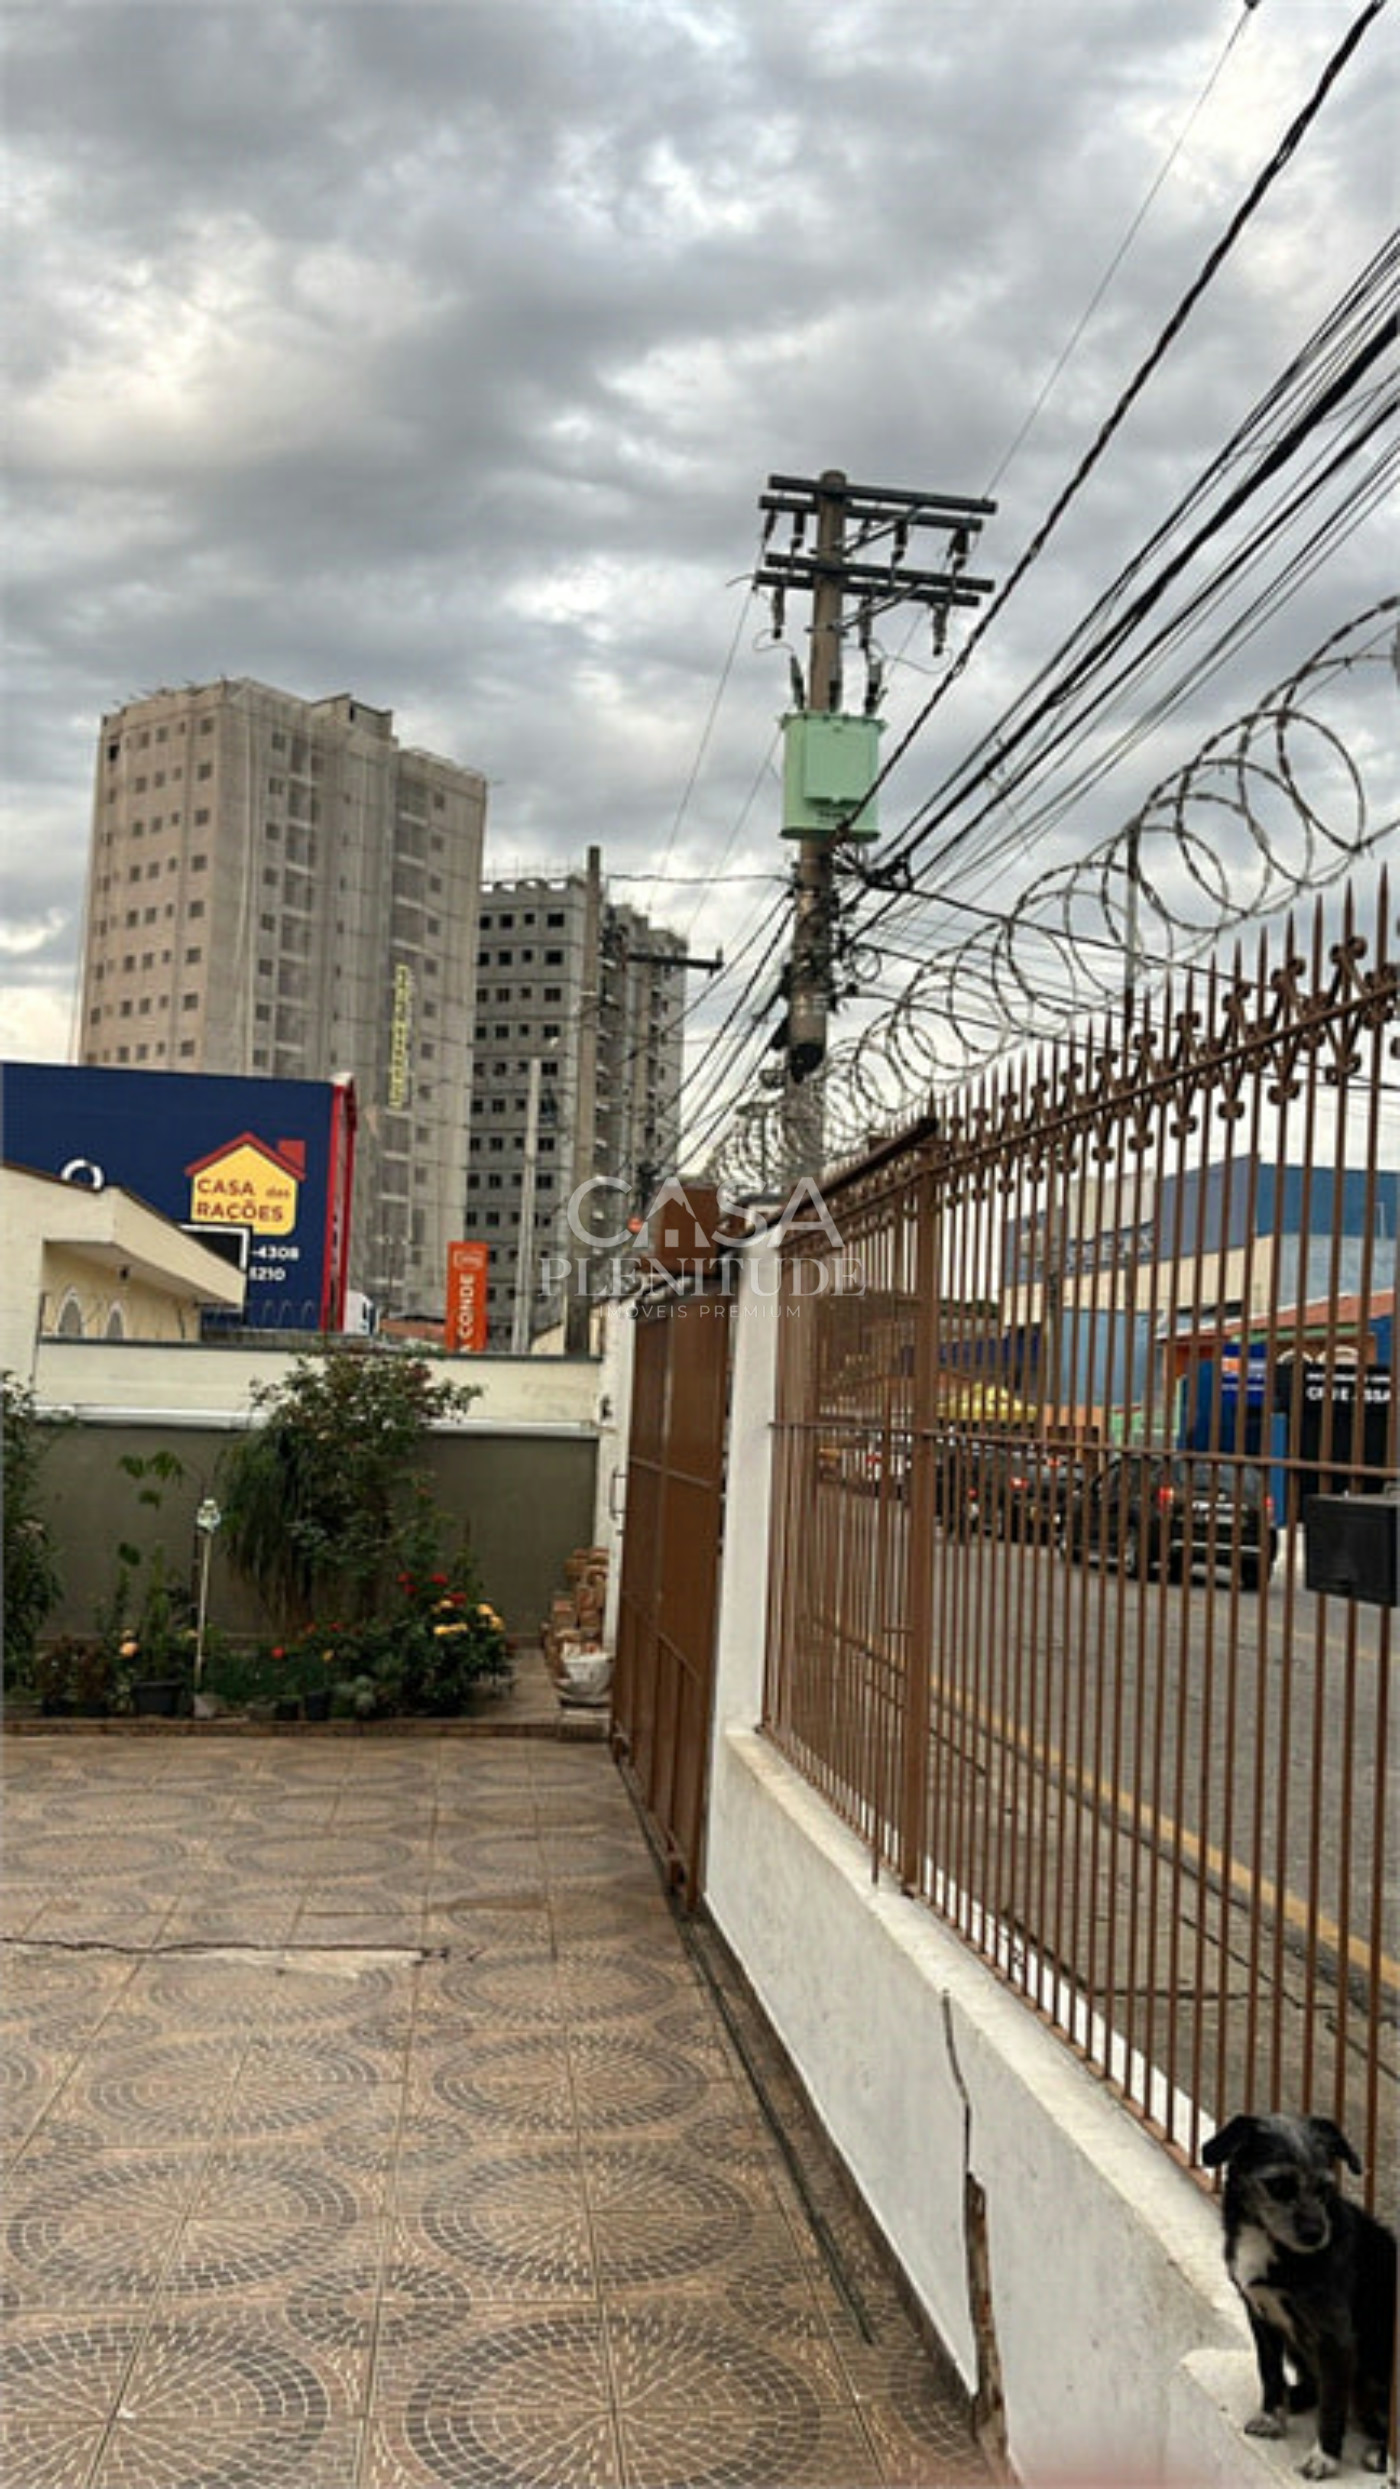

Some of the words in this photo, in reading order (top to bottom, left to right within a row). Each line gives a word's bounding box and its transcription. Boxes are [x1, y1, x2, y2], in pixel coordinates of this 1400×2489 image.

[197, 1178, 255, 1196] CASA
[265, 1186, 291, 1199] das
[197, 1200, 283, 1222] RAÇÕES
[458, 1273, 475, 1339] CONDE
